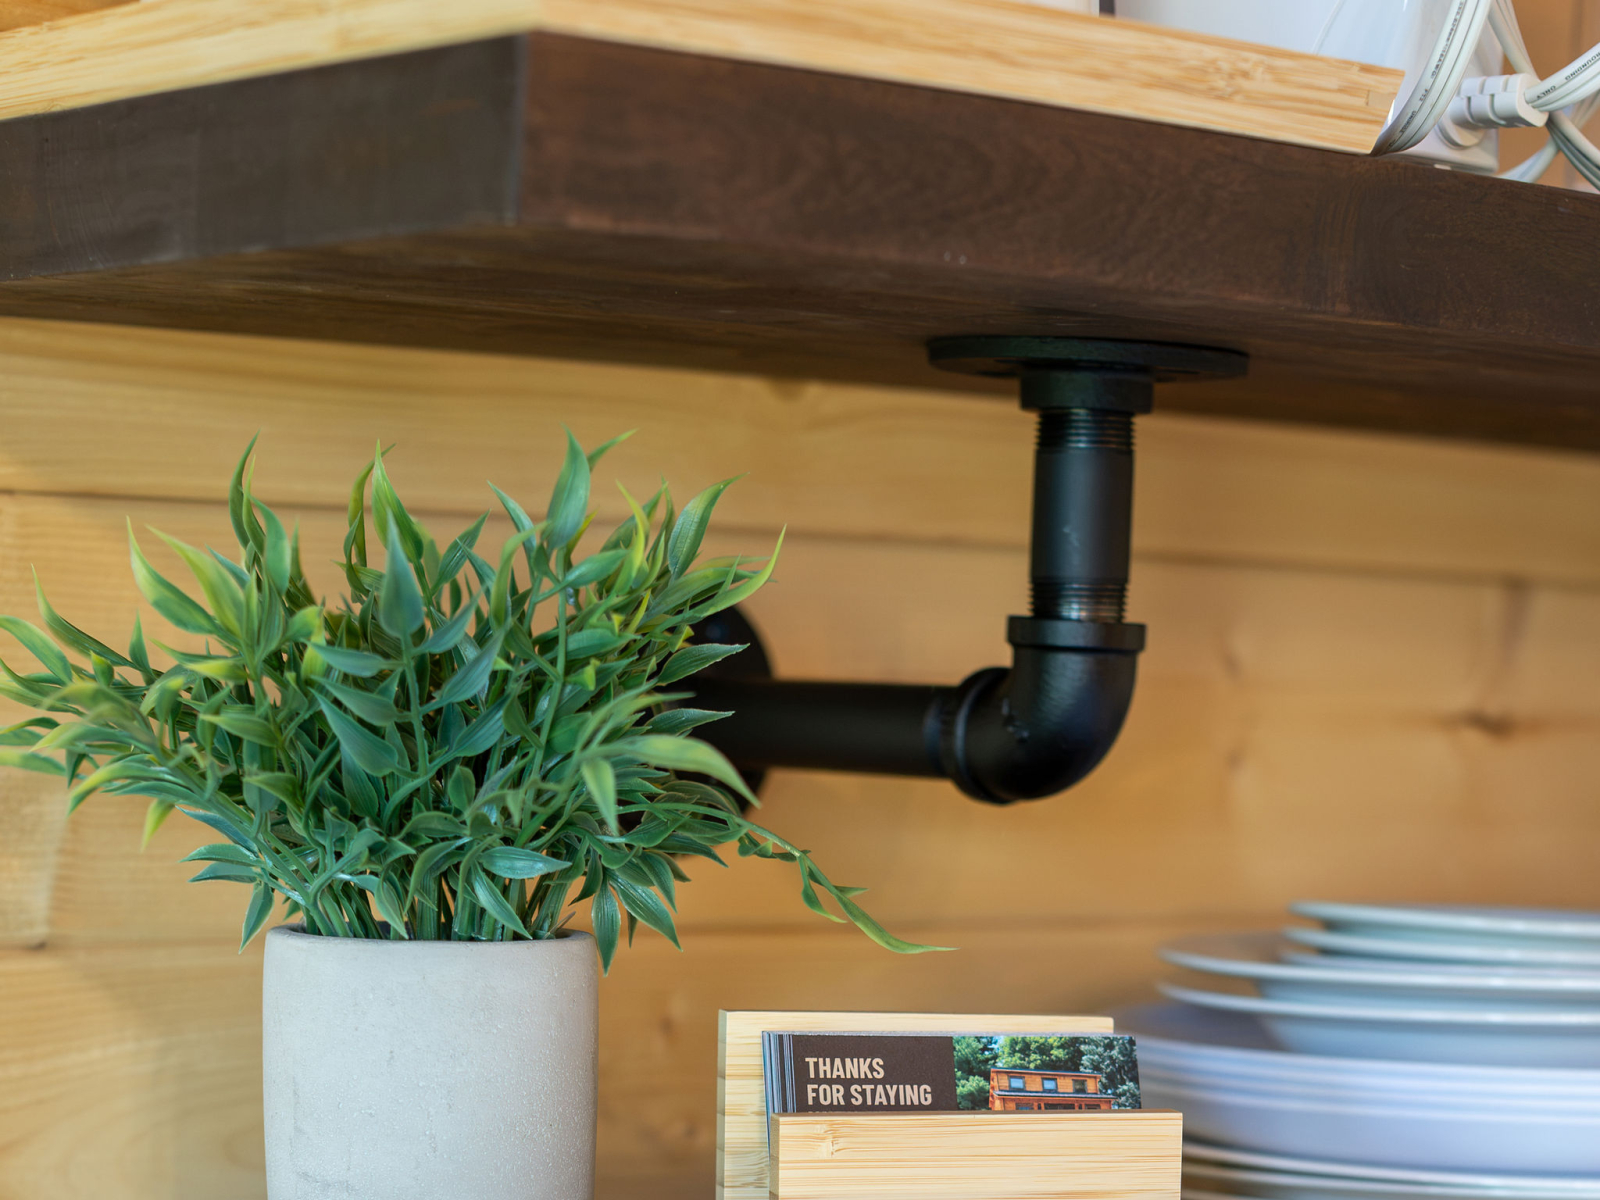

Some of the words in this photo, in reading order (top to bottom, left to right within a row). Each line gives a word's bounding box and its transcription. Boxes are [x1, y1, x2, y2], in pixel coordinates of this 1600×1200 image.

[1536, 85, 1556, 100] ONLY
[805, 1057, 885, 1079] THANKS
[806, 1084, 846, 1106] FOR
[850, 1084, 933, 1106] STAYING
